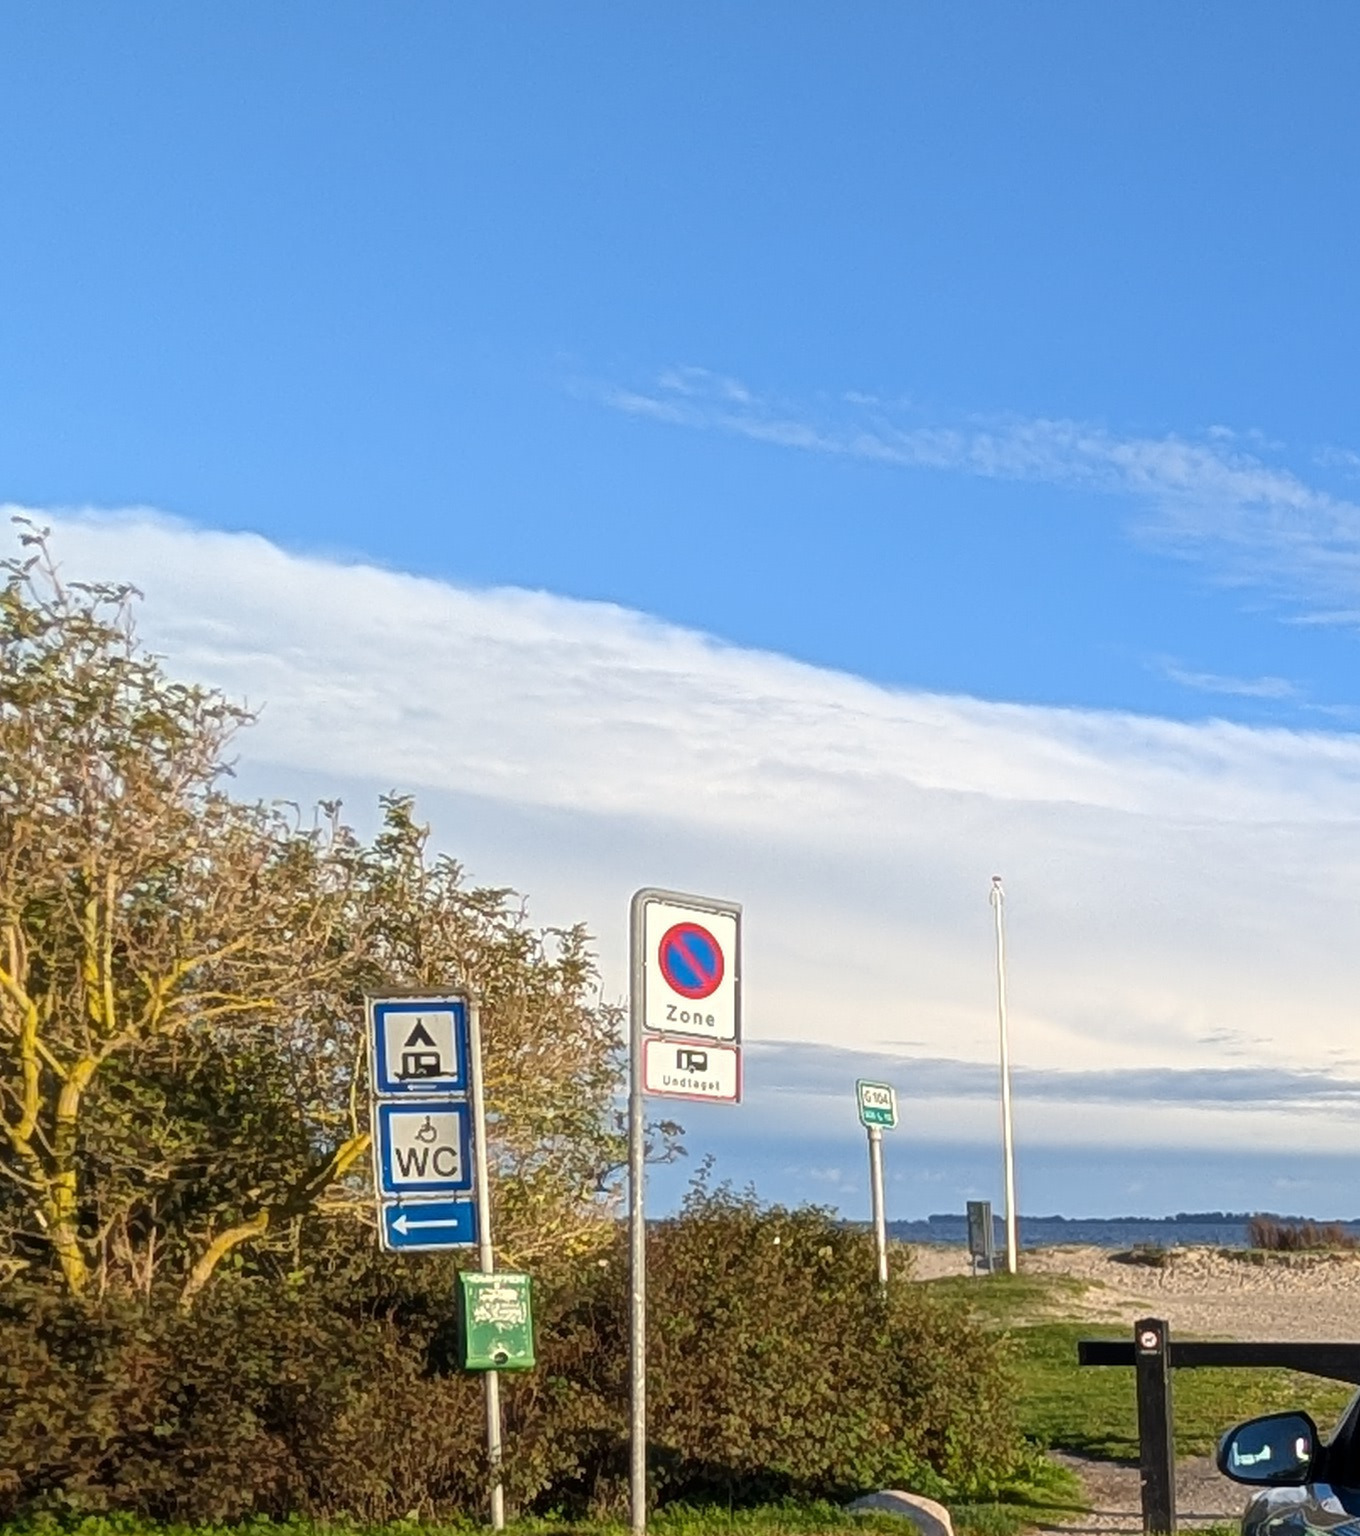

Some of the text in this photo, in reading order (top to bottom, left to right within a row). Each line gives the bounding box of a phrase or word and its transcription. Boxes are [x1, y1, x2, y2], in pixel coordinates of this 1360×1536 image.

[666, 1004, 715, 1027] Zone
[662, 1075, 720, 1091] Undtaget
[395, 1146, 457, 1178] WC
